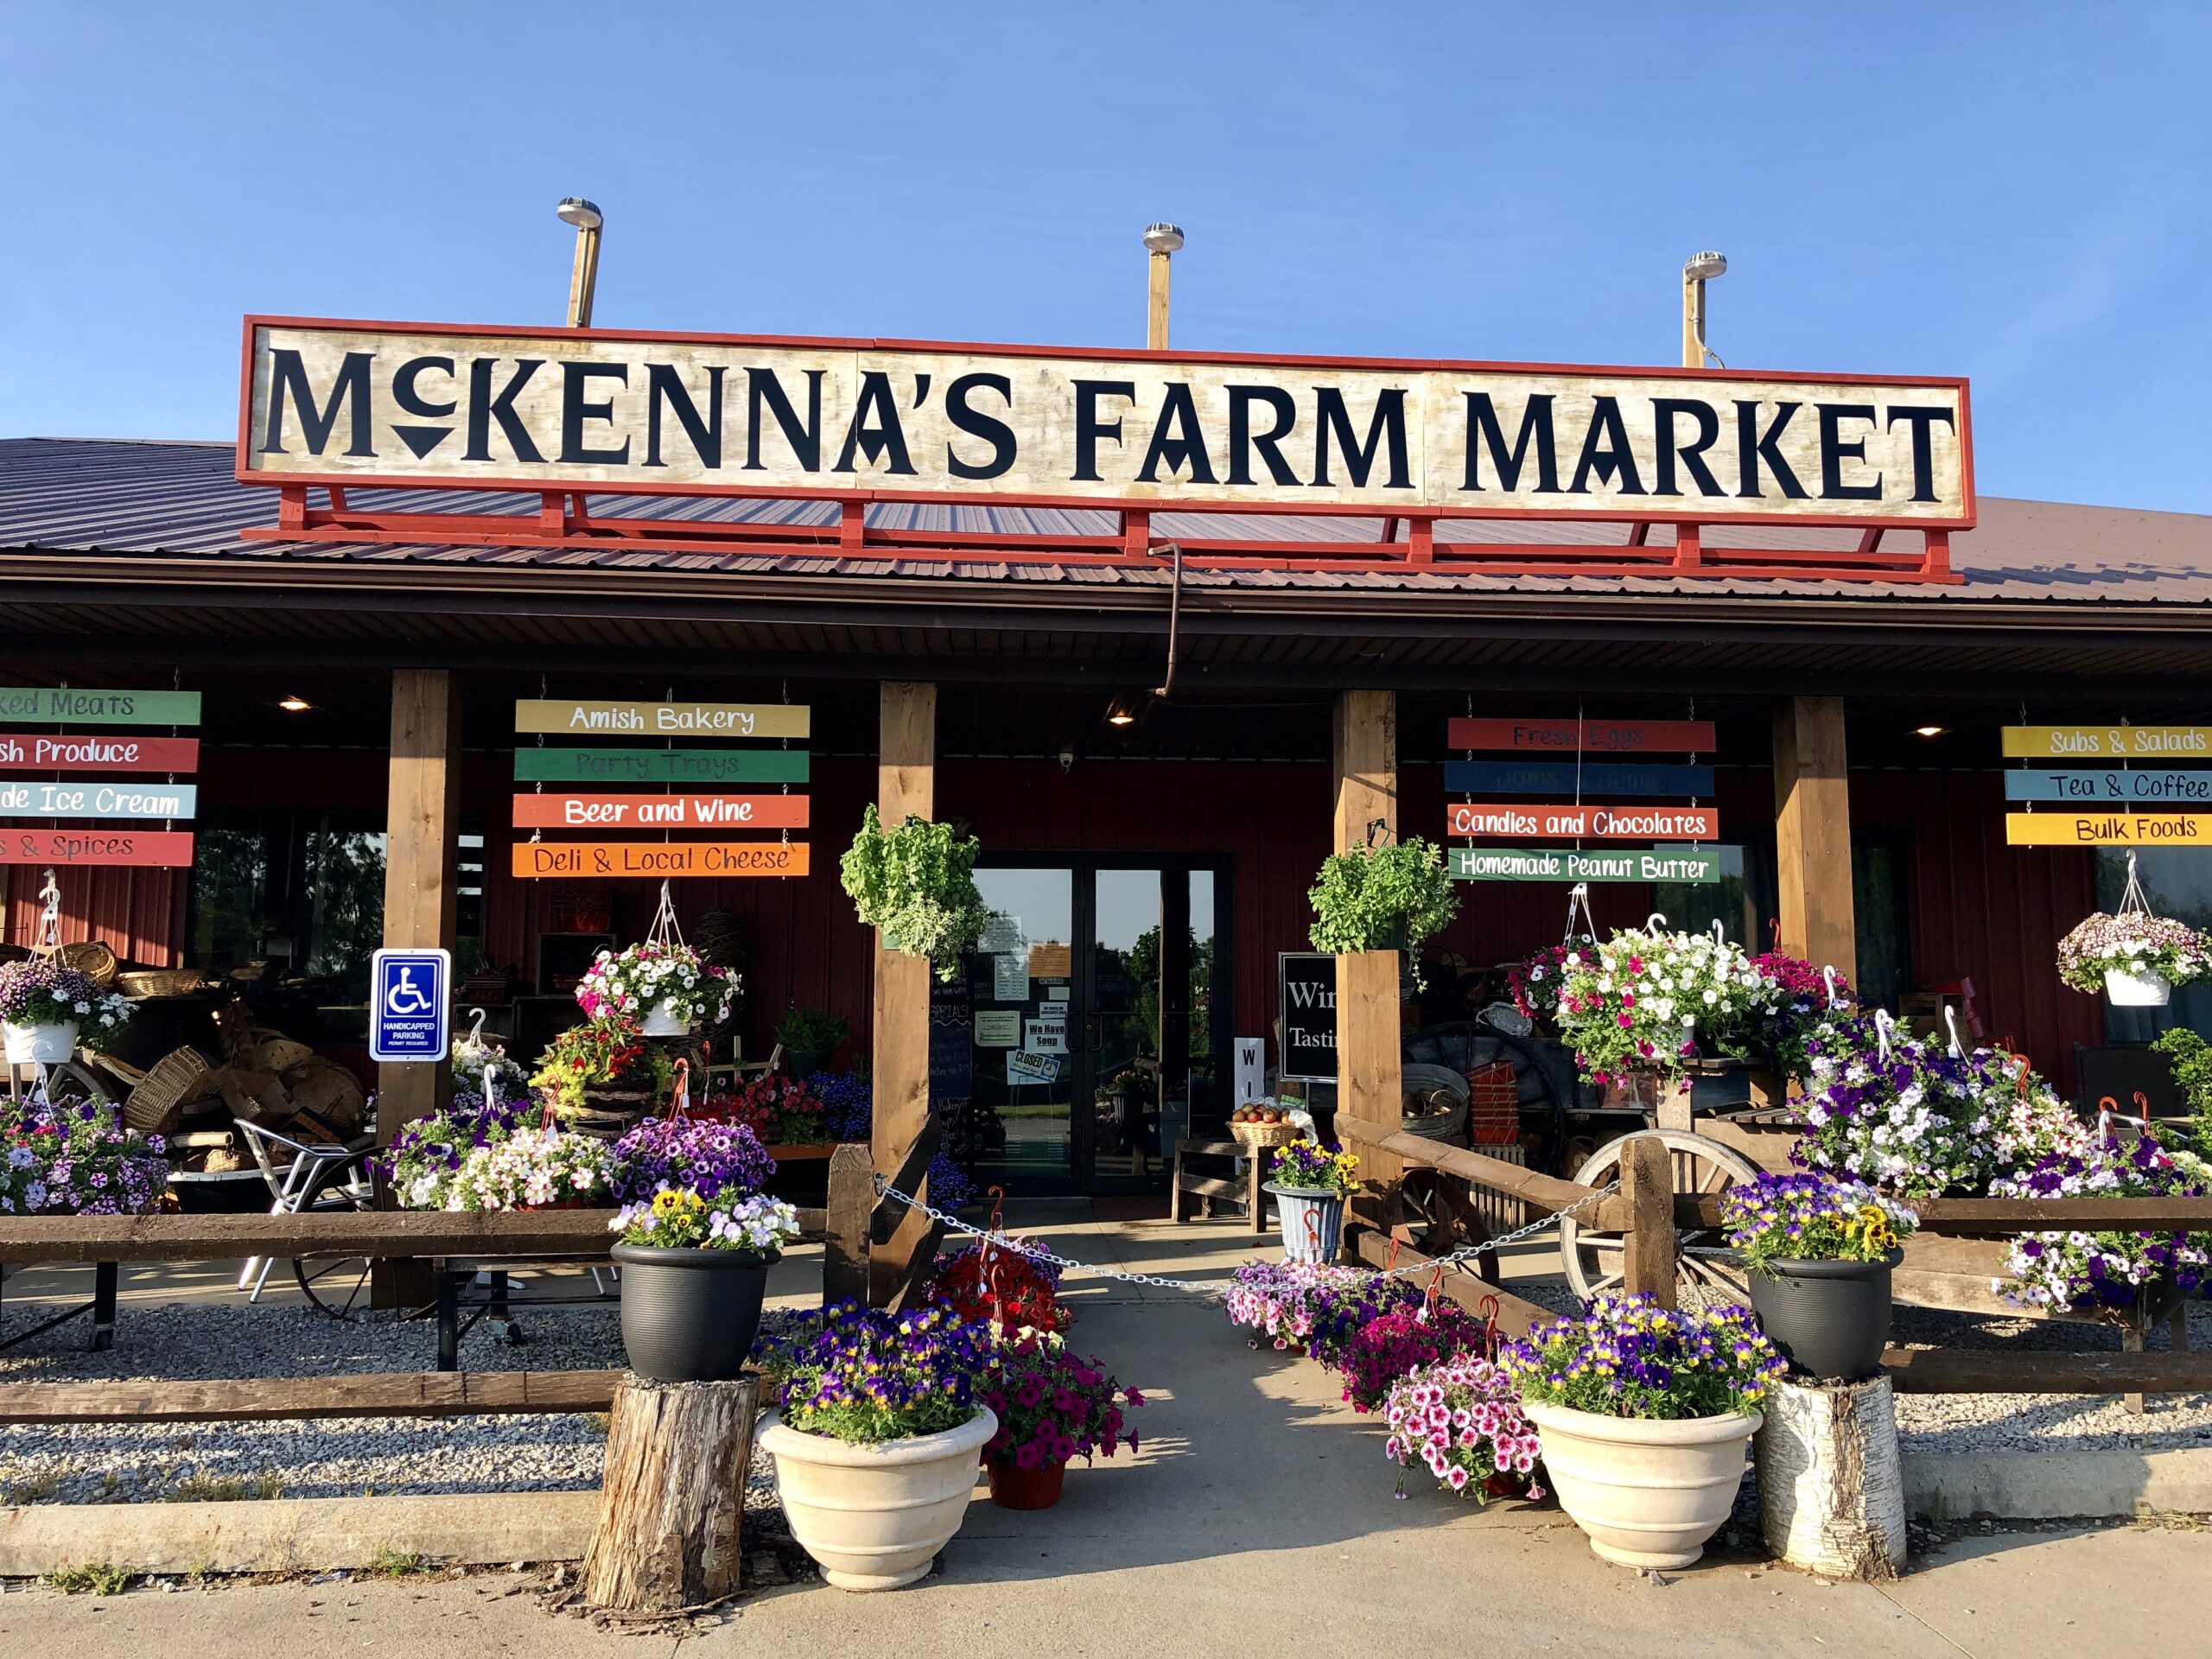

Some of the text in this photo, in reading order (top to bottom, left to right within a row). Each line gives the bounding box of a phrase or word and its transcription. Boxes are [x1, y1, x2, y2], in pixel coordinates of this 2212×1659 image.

[1070, 379, 1416, 490] FARM
[1458, 391, 1956, 503] MARKET
[50, 692, 135, 716] Meats
[569, 707, 756, 735] Amish Bakery
[35, 739, 140, 763] Produce
[1513, 726, 1645, 751] Fresh Eggs
[2050, 729, 2207, 754] Subs & Salads
[575, 753, 740, 779] Party Trays
[2050, 773, 2210, 798] Tea & Coffee
[40, 786, 85, 812] Ice
[96, 788, 180, 816] Cream
[565, 798, 753, 823] Beer and Wine
[1455, 809, 1707, 836] Candies and Chocolates
[2075, 816, 2197, 841] Bulk Foods
[21, 835, 40, 857] &
[50, 836, 134, 861] Spices
[534, 847, 790, 873] Deli & Local Cheese
[1461, 852, 1709, 879] Homemade Peanut Butter
[1287, 982, 1337, 1009] Wi
[1029, 1024, 1065, 1033] We Have
[1289, 1027, 1338, 1048] Tasti
[1037, 1037, 1058, 1046] Soup
[1015, 1051, 1043, 1068] CLOSED
